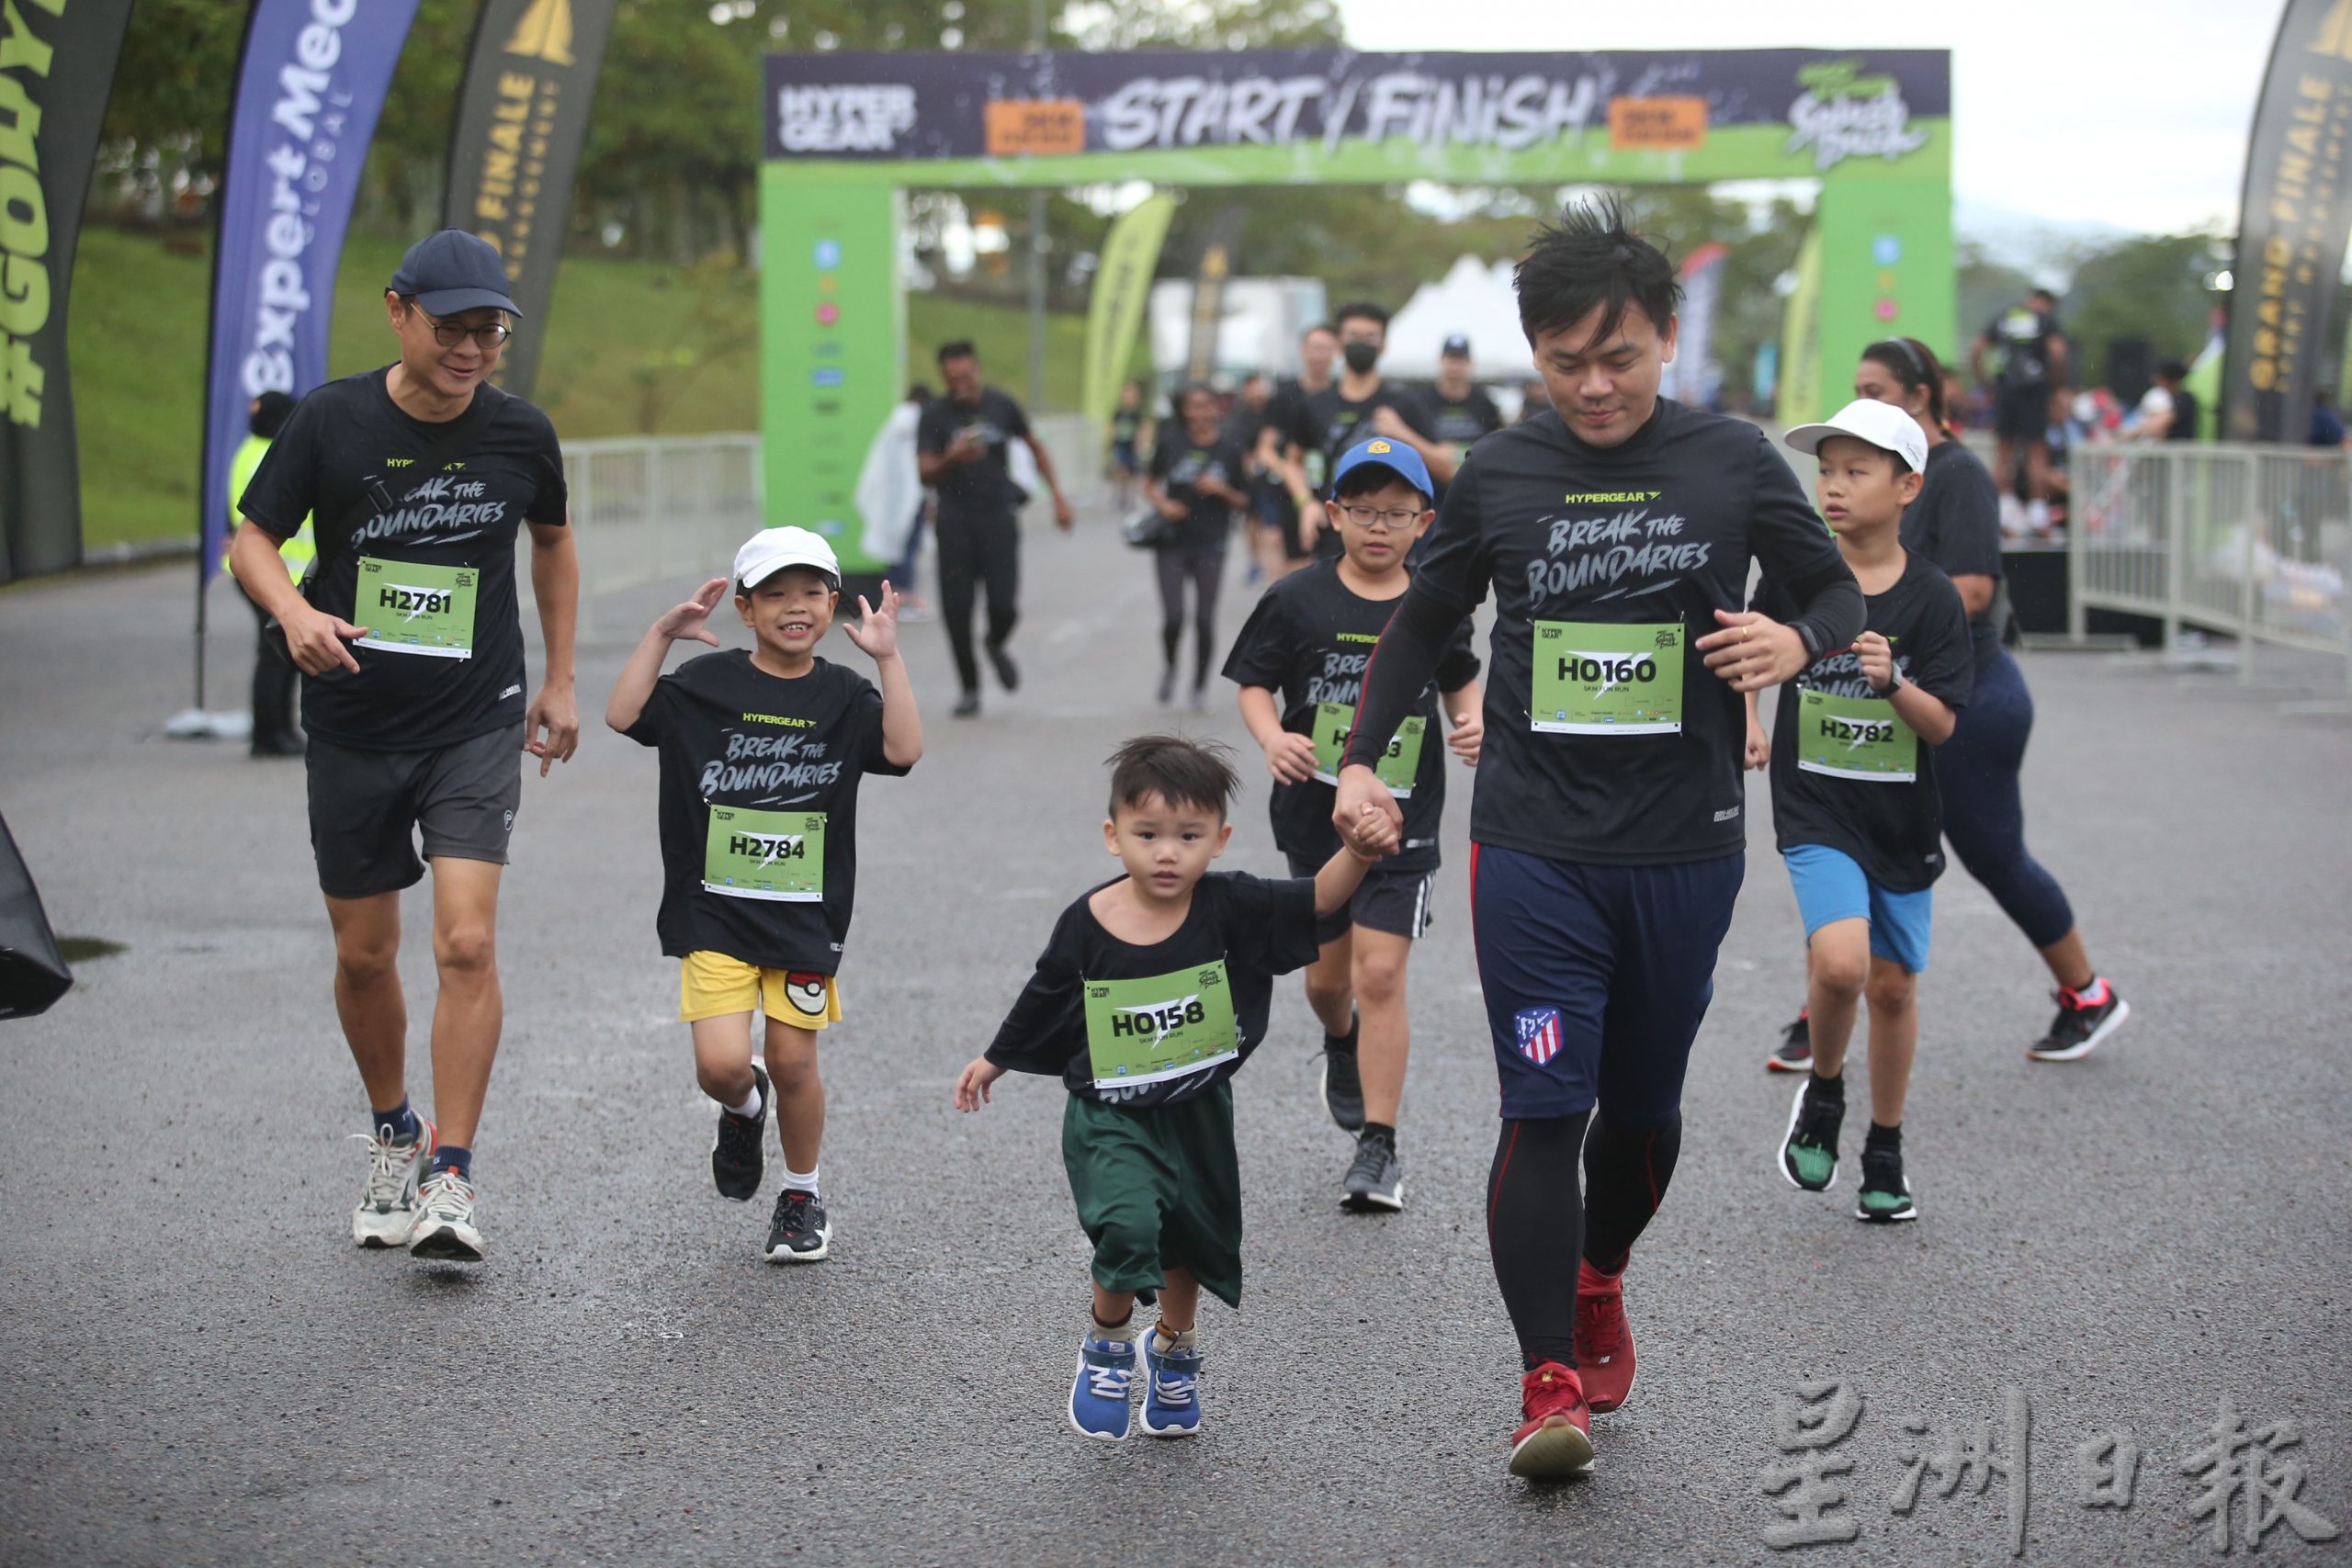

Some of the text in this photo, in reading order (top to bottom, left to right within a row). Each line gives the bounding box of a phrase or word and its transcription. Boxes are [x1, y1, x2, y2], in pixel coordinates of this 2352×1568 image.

[778, 83, 917, 130] HYPER
[1104, 74, 1326, 150] START
[475, 71, 536, 221] FINALE
[779, 119, 896, 152] GEAR
[301, 90, 354, 246] GLOBAL
[453, 480, 487, 499] THE
[1566, 492, 1645, 503] HYPERGEAR
[1546, 508, 1686, 558] BREAK THE
[1526, 540, 1713, 610] BOUNDARIES
[379, 589, 451, 615] H2781
[742, 713, 806, 728] HYPERGEAR
[1820, 720, 1894, 743] H2782
[725, 734, 827, 762] BREAK THE
[698, 760, 843, 797] BOUNDARIES
[730, 836, 805, 859] H2784
